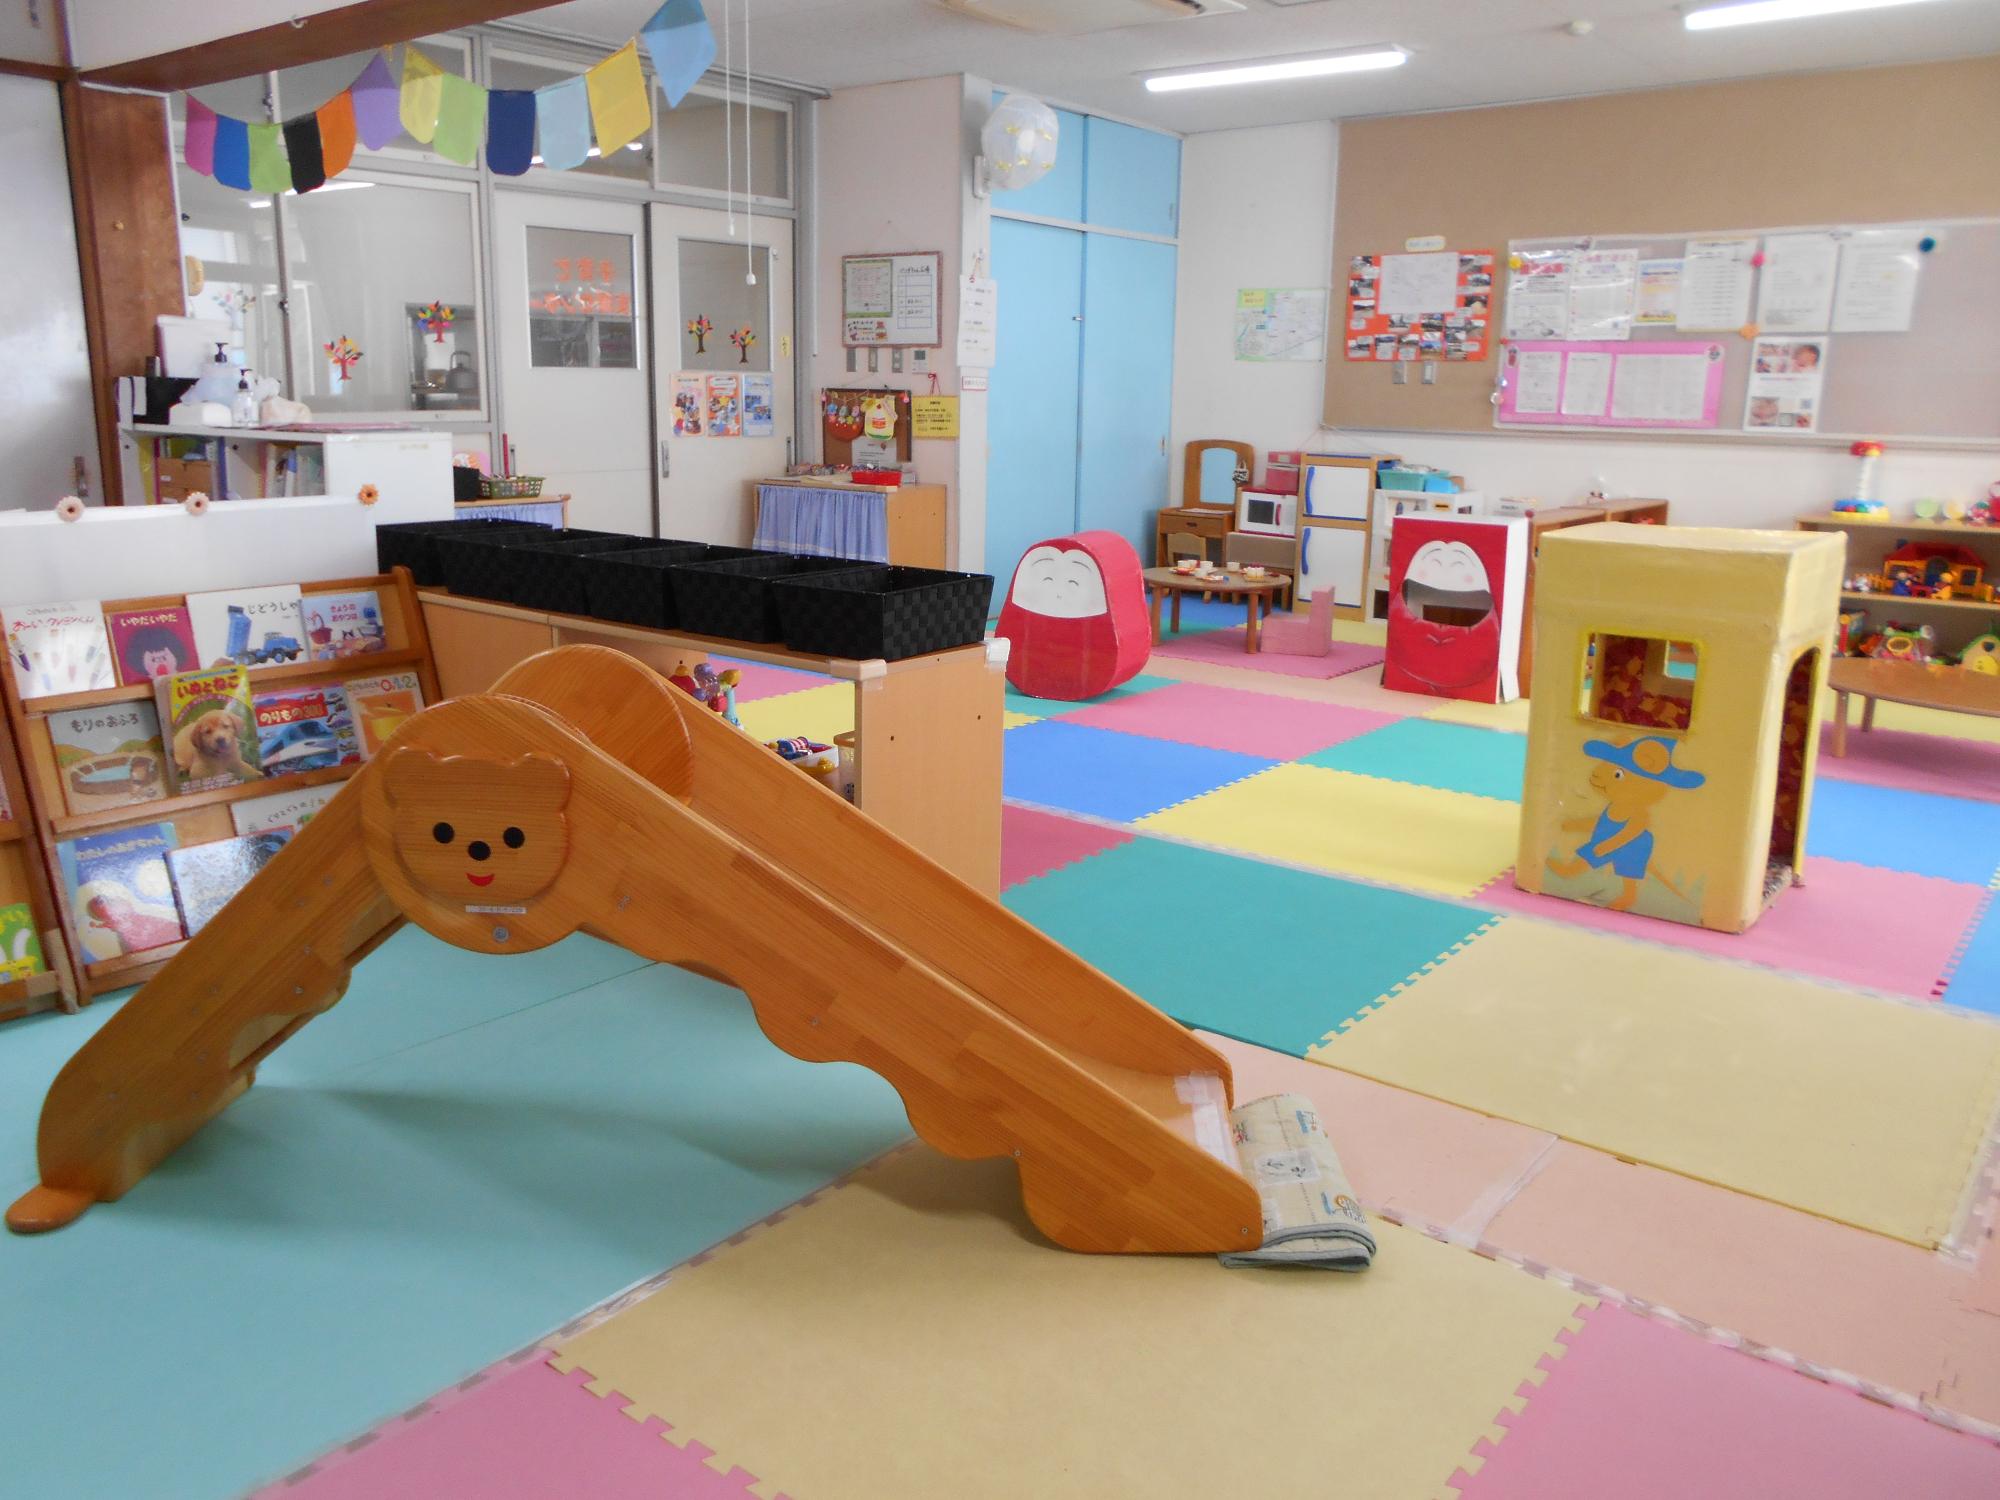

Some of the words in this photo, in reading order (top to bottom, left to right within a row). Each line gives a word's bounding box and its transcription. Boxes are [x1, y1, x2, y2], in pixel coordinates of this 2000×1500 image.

[247, 601, 298, 615] じどうしゃ
[120, 613, 177, 627] いやだいやだ
[71, 713, 139, 733] もりのおふろ
